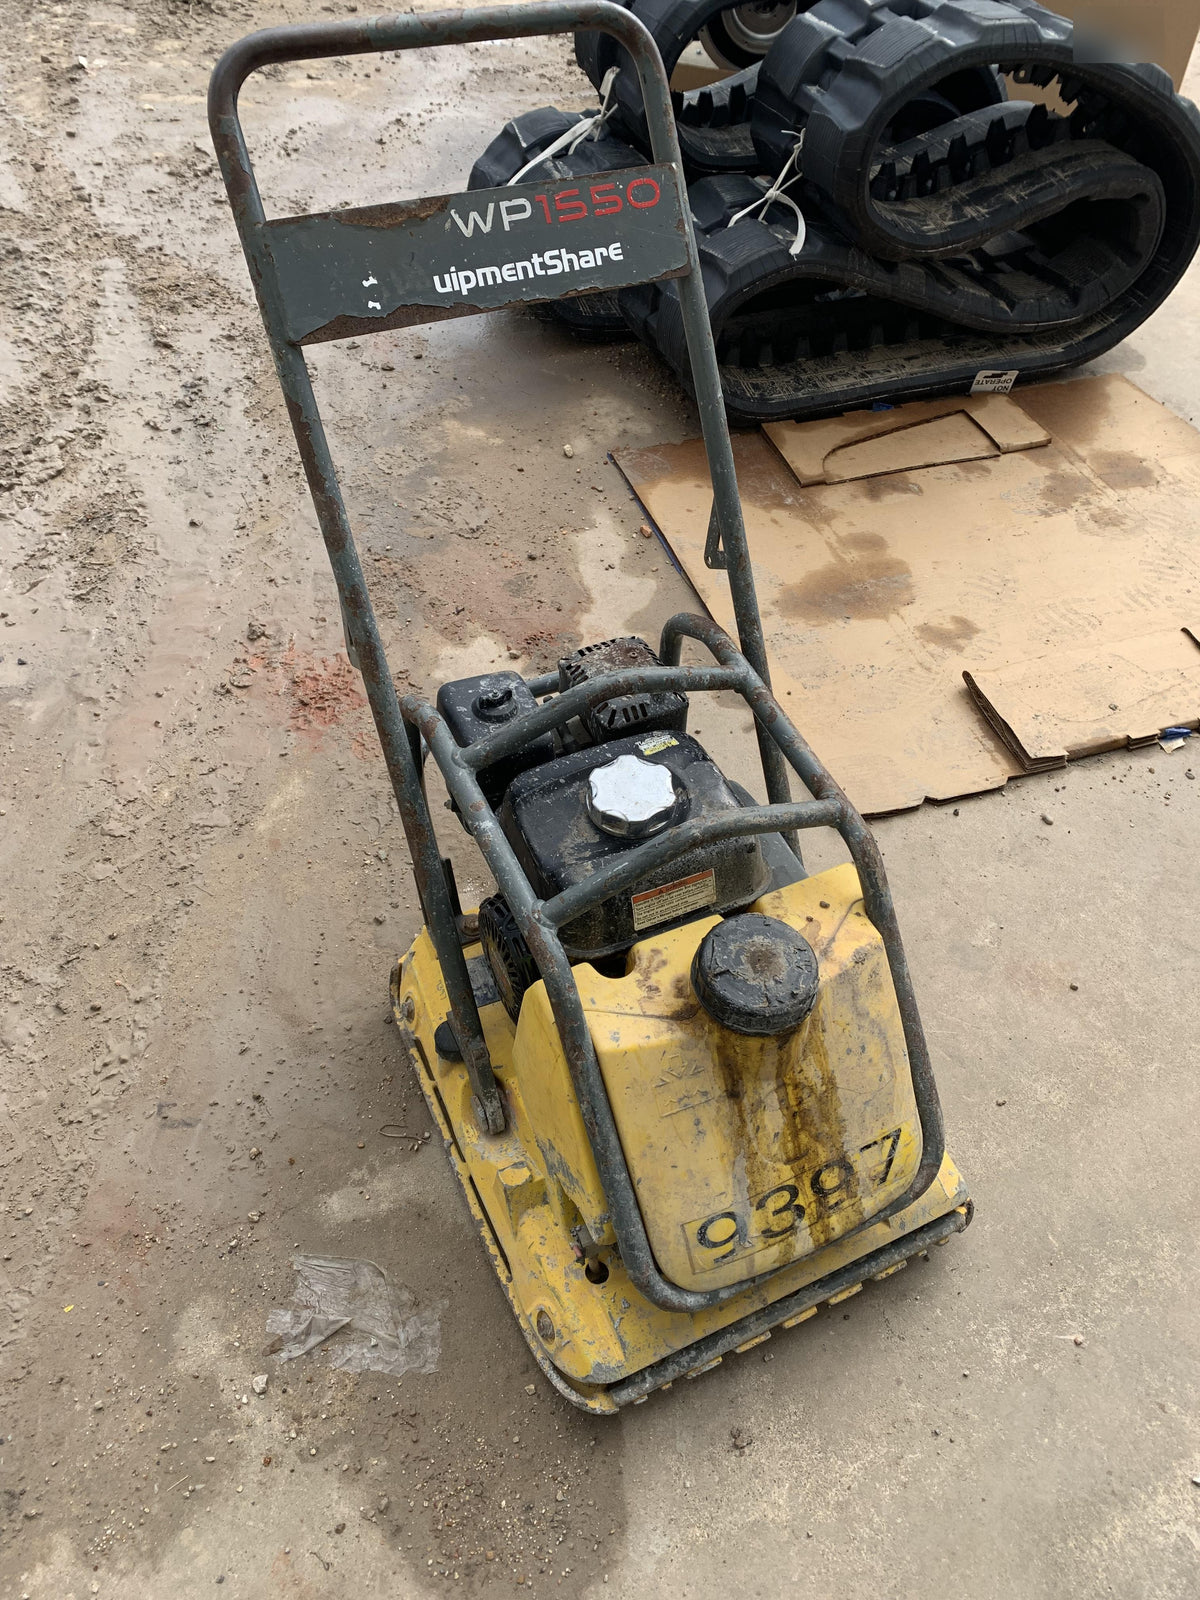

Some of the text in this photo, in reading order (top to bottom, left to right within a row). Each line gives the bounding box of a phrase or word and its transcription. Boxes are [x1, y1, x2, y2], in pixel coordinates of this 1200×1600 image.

[450, 178, 661, 238] WP1550
[974, 378, 1012, 386] OPERATE
[696, 1128, 902, 1264] 9397
